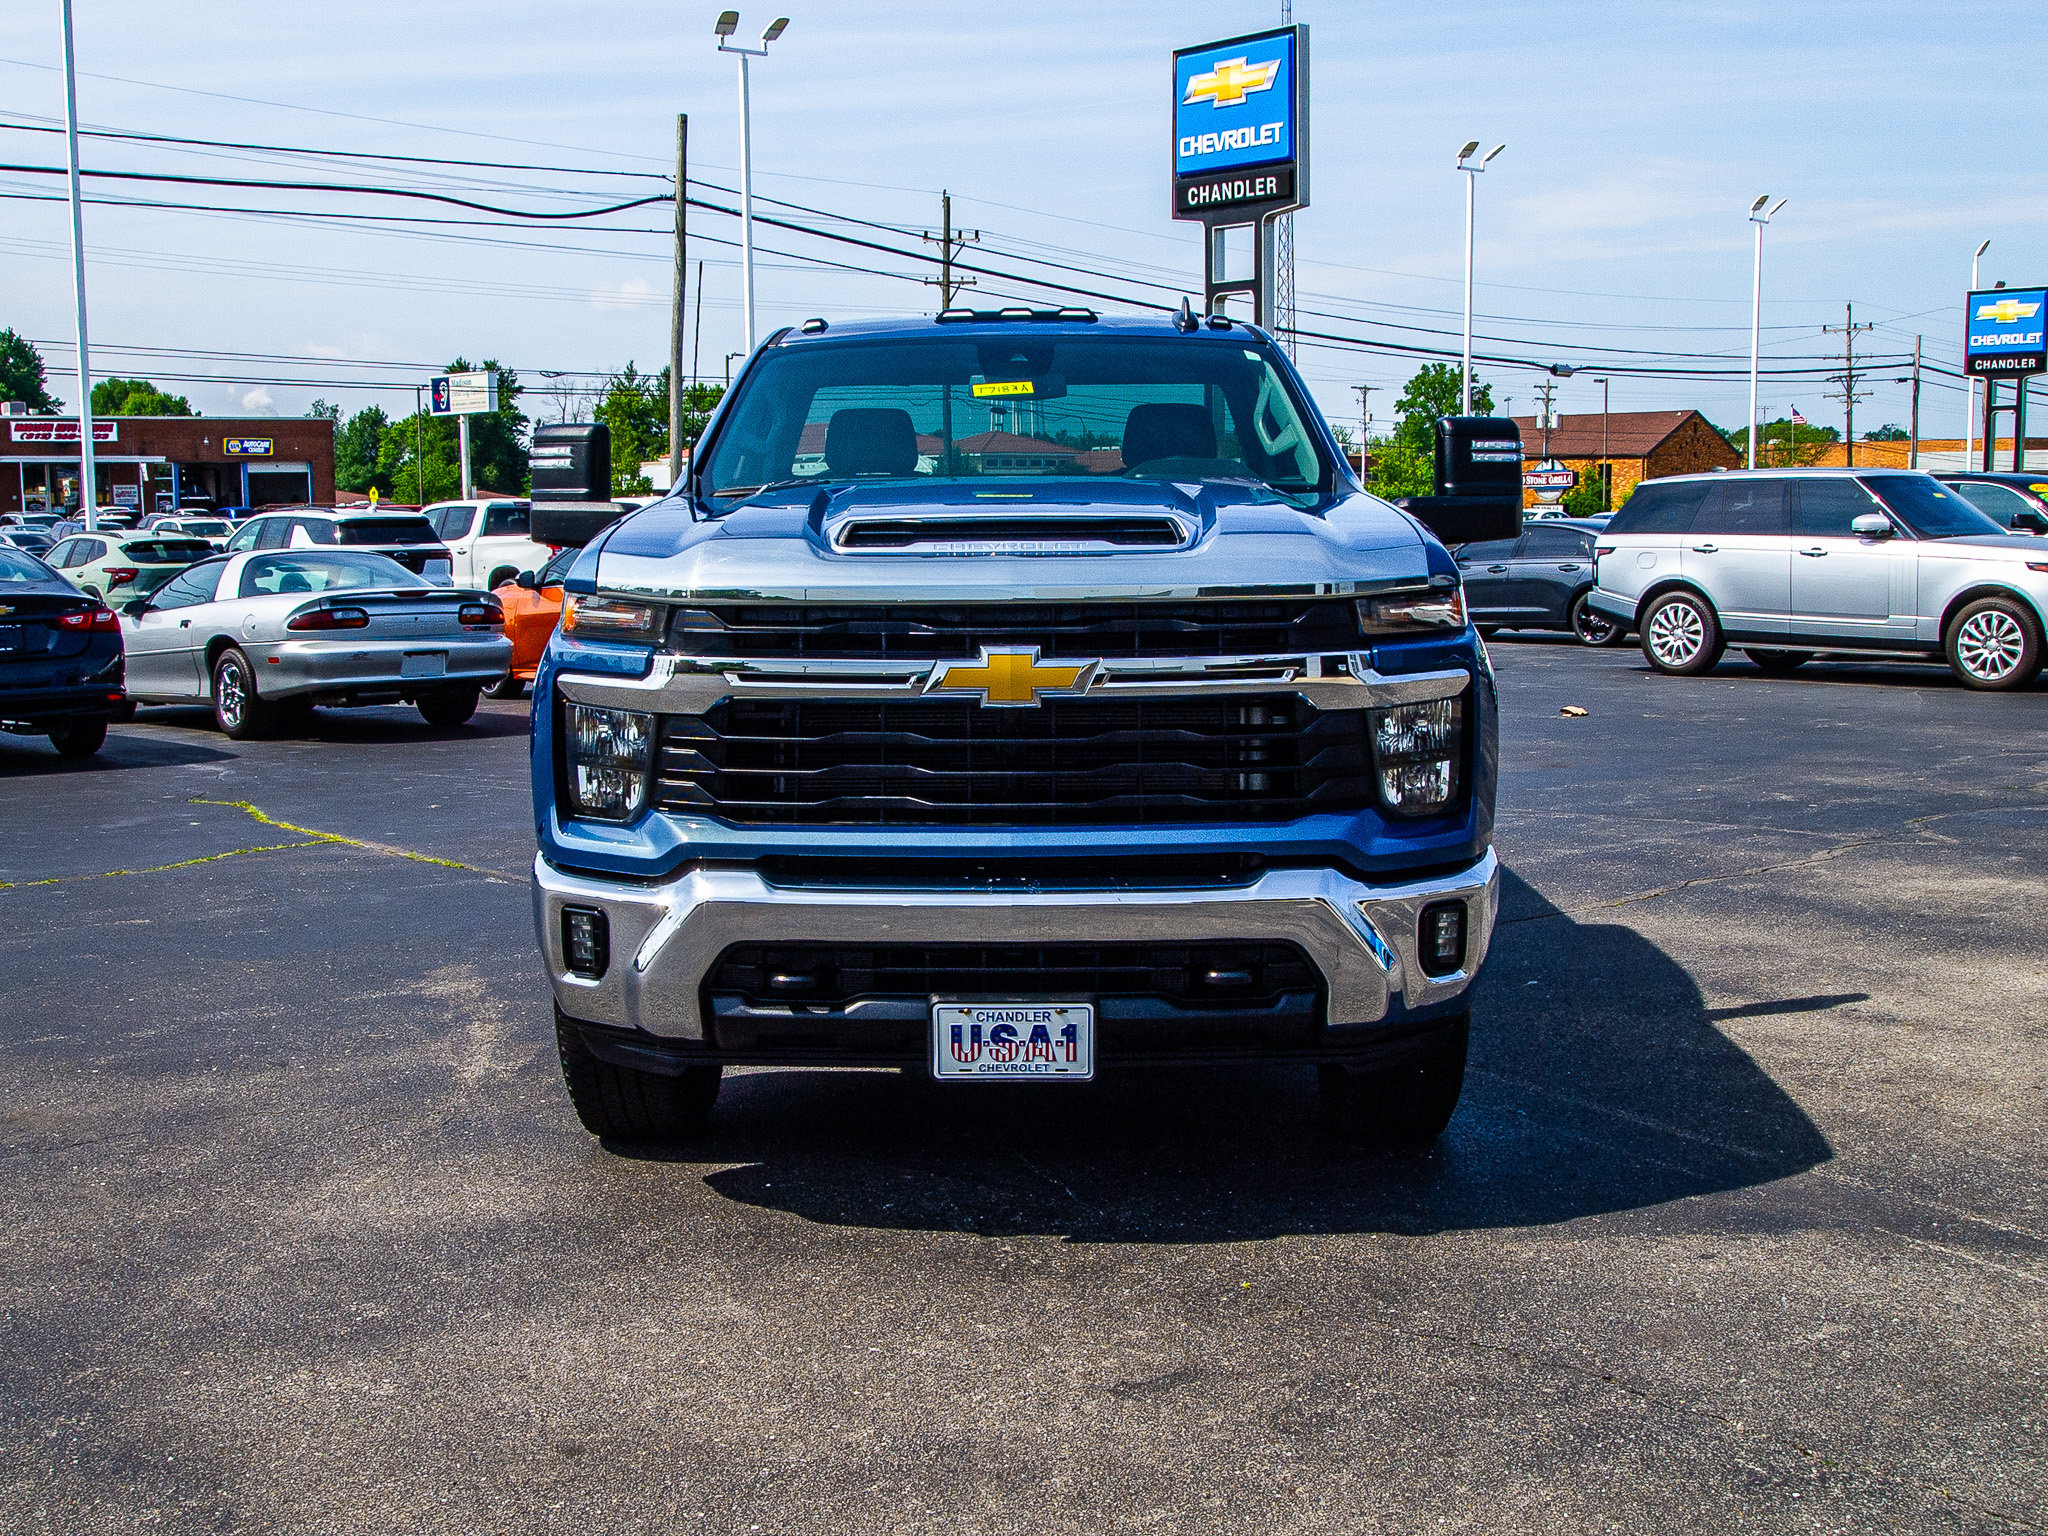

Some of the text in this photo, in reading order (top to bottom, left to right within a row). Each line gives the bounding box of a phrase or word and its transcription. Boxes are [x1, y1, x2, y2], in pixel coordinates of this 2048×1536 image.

[1179, 121, 1284, 158] CHEVROLET
[1187, 176, 1277, 206] CHANDLER
[1970, 332, 2043, 347] CHEVROLET
[1975, 358, 2036, 370] CHANDLER
[1526, 475, 1548, 485] STONE
[933, 542, 1088, 552] CHEVROLET
[976, 1011, 1052, 1022] CHANDLER
[978, 1063, 1050, 1073] CHEVROLET
